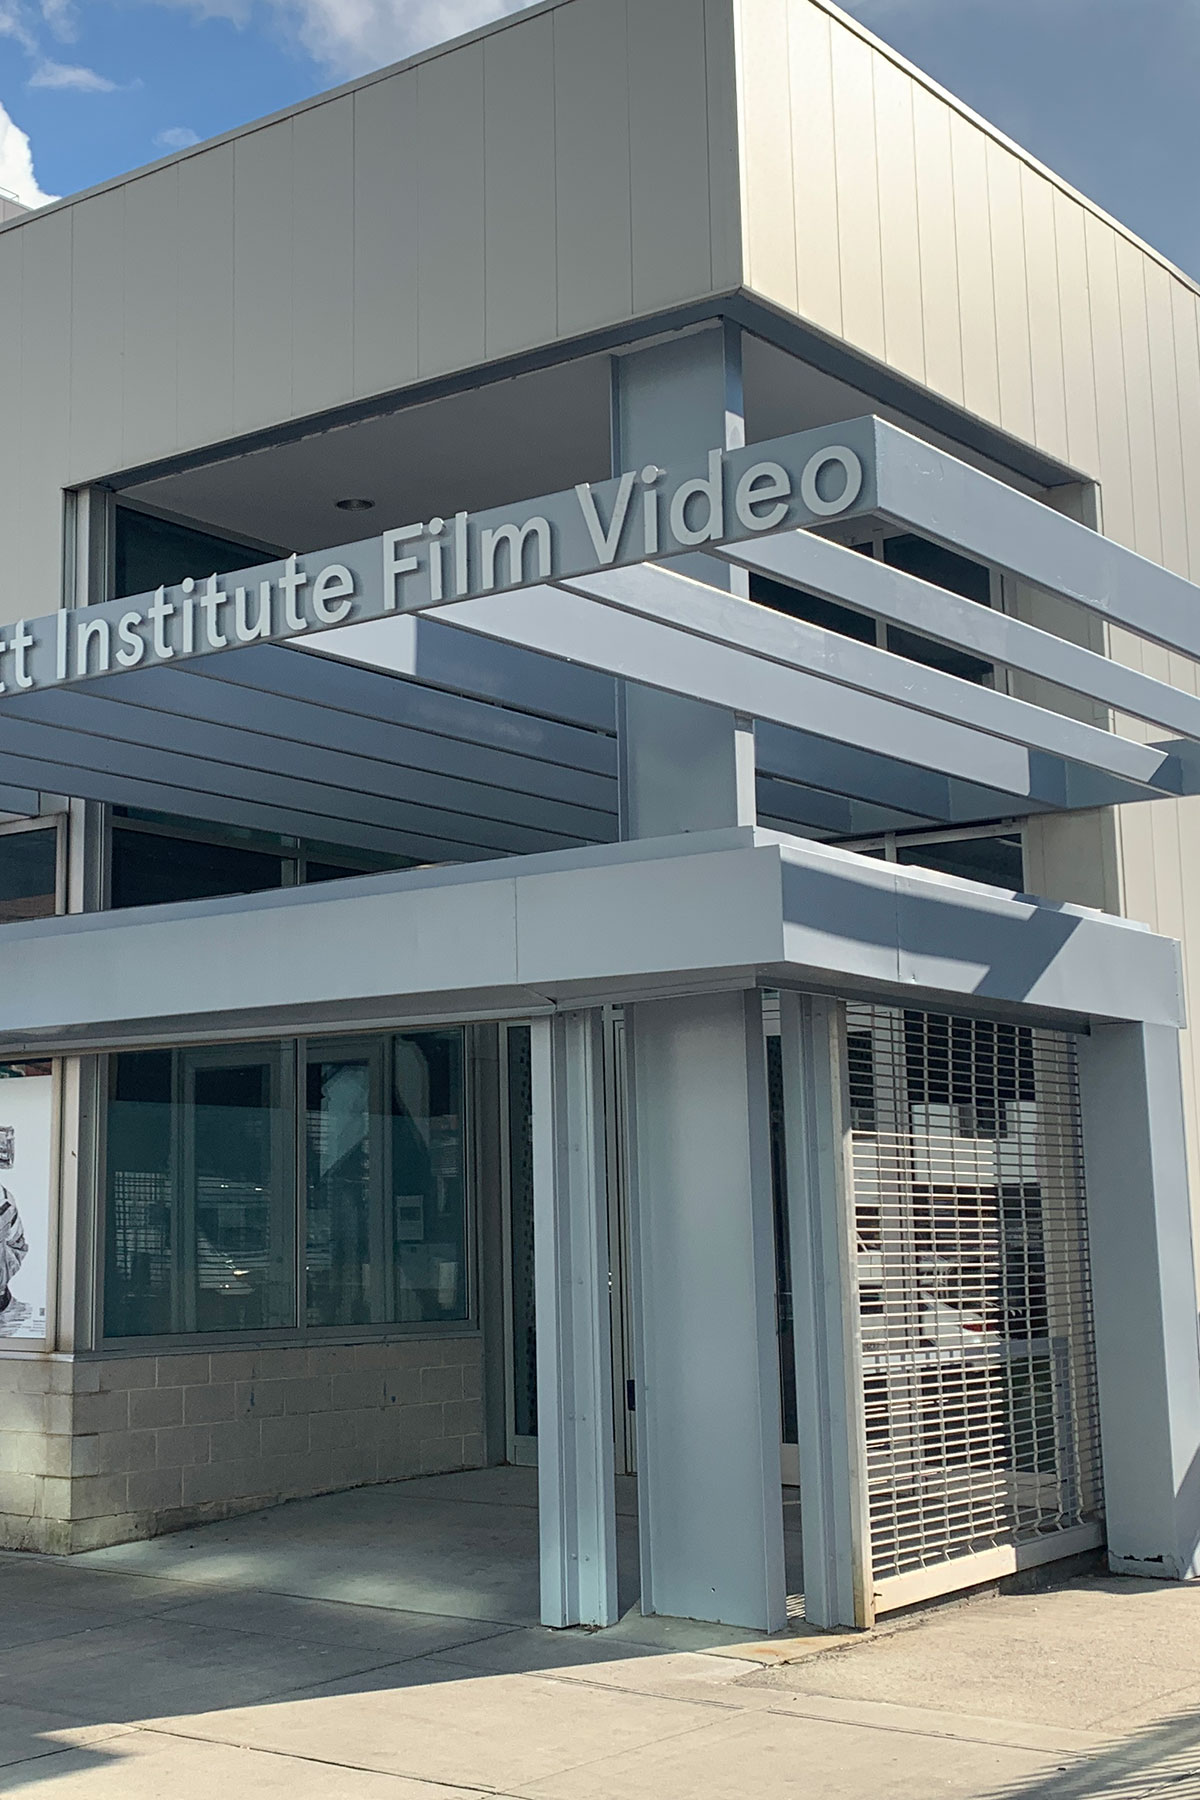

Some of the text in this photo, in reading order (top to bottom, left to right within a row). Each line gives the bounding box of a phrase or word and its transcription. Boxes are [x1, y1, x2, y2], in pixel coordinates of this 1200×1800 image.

[56, 552, 355, 680] Institute
[382, 511, 552, 611] Film
[575, 445, 863, 564] Video
